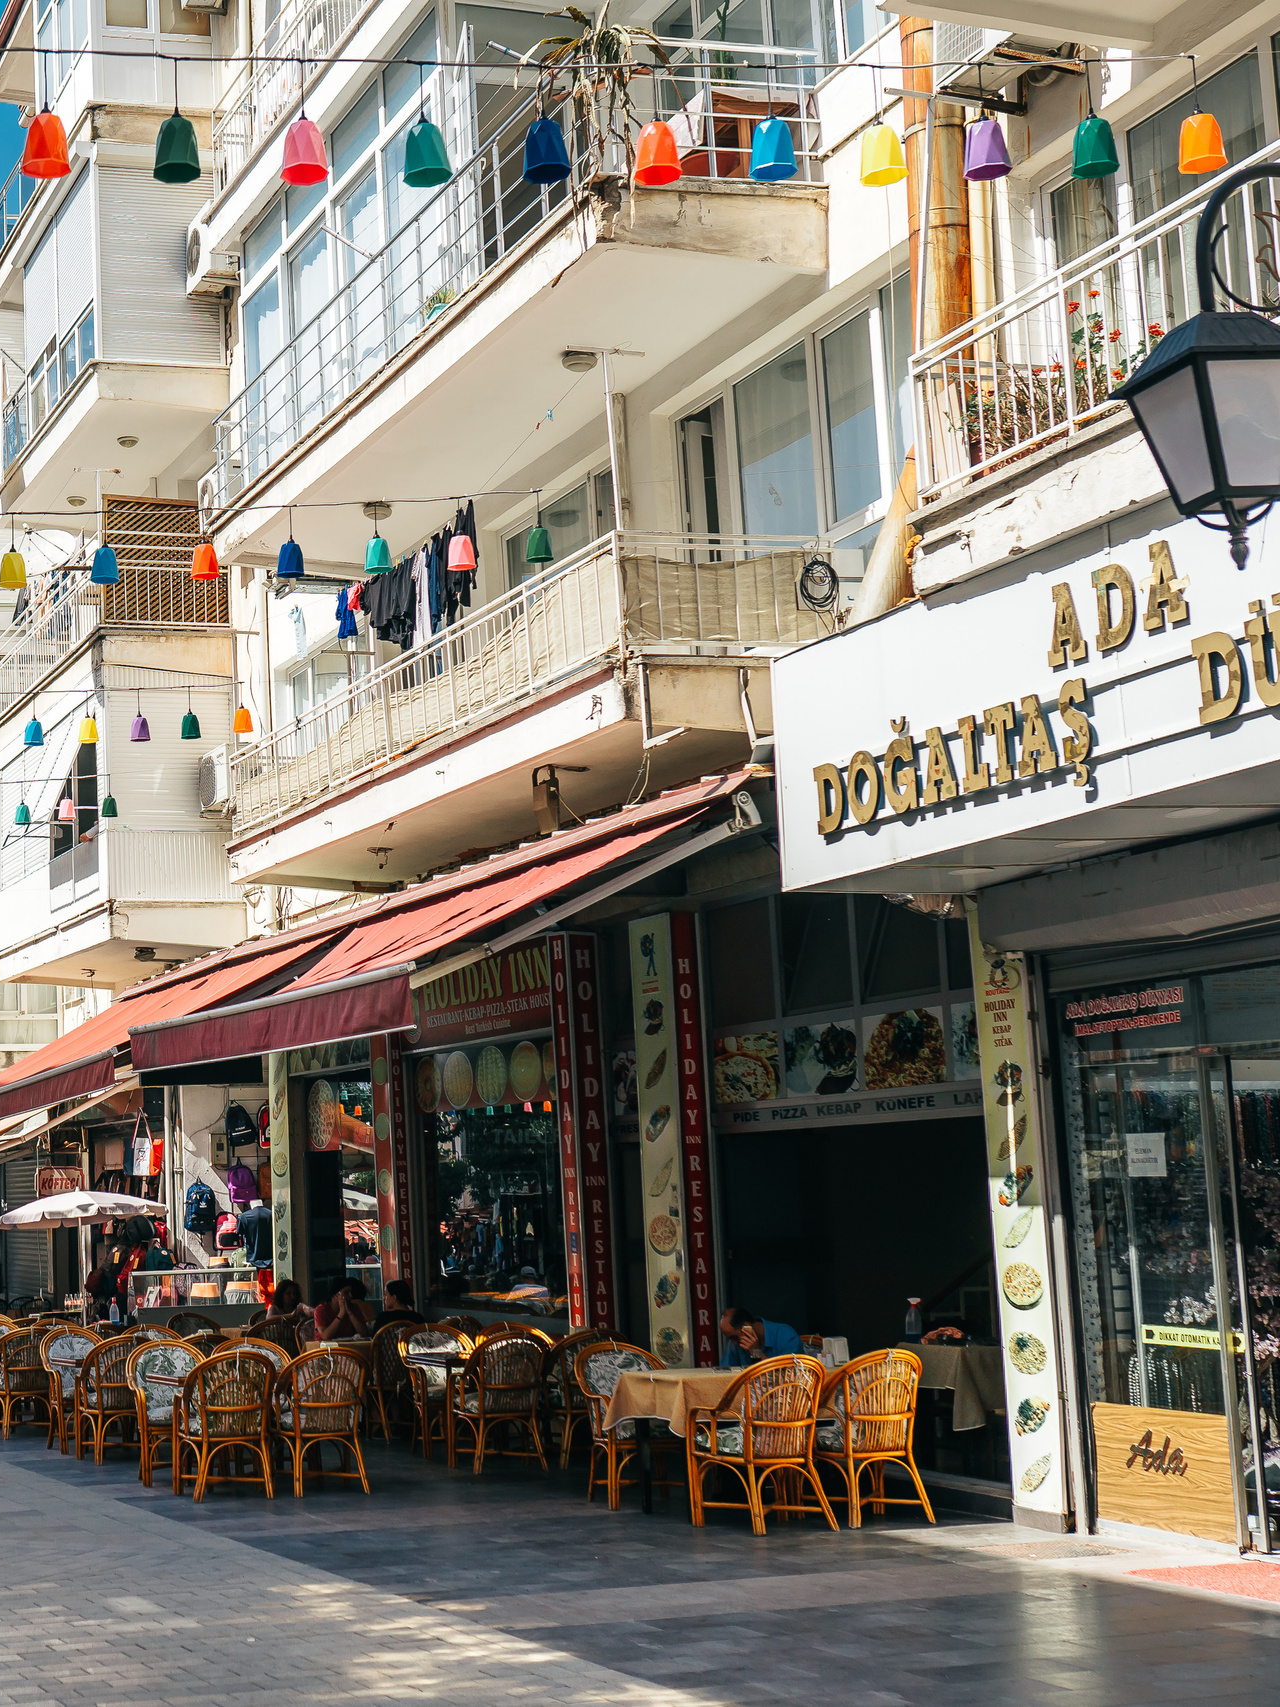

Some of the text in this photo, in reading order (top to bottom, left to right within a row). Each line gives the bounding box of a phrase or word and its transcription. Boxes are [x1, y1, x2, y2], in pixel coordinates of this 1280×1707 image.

[1048, 540, 1190, 667] ADA
[813, 678, 1093, 836] DOĞALTAŞ
[422, 956, 504, 1012] HOLIDAY
[984, 998, 1016, 1012] HOLIDAY
[1065, 986, 1184, 1019] ADA DOĞALTAŞ DÜNYASI
[465, 1024, 475, 1035] Best
[493, 1018, 511, 1030] Cuisine
[992, 1024, 1012, 1035] KEBAP
[993, 1011, 1008, 1022] INN
[678, 958, 698, 1125] HOLIDAY
[993, 1037, 1013, 1048] STEAK
[552, 940, 573, 1154] HOLIDAY
[564, 1168, 576, 1178] INN
[575, 949, 601, 1162] HOLIDAY
[391, 1050, 404, 1154] HOLIDAY
[816, 1102, 862, 1117] KEBAP
[876, 1095, 936, 1113] KÜNEFE
[685, 1135, 701, 1144] INN
[585, 1175, 606, 1186] INN
[1159, 1330, 1179, 1342] DİKKAT
[1180, 1333, 1211, 1345] OTOMATİK
[1126, 1427, 1188, 1476] Ada
